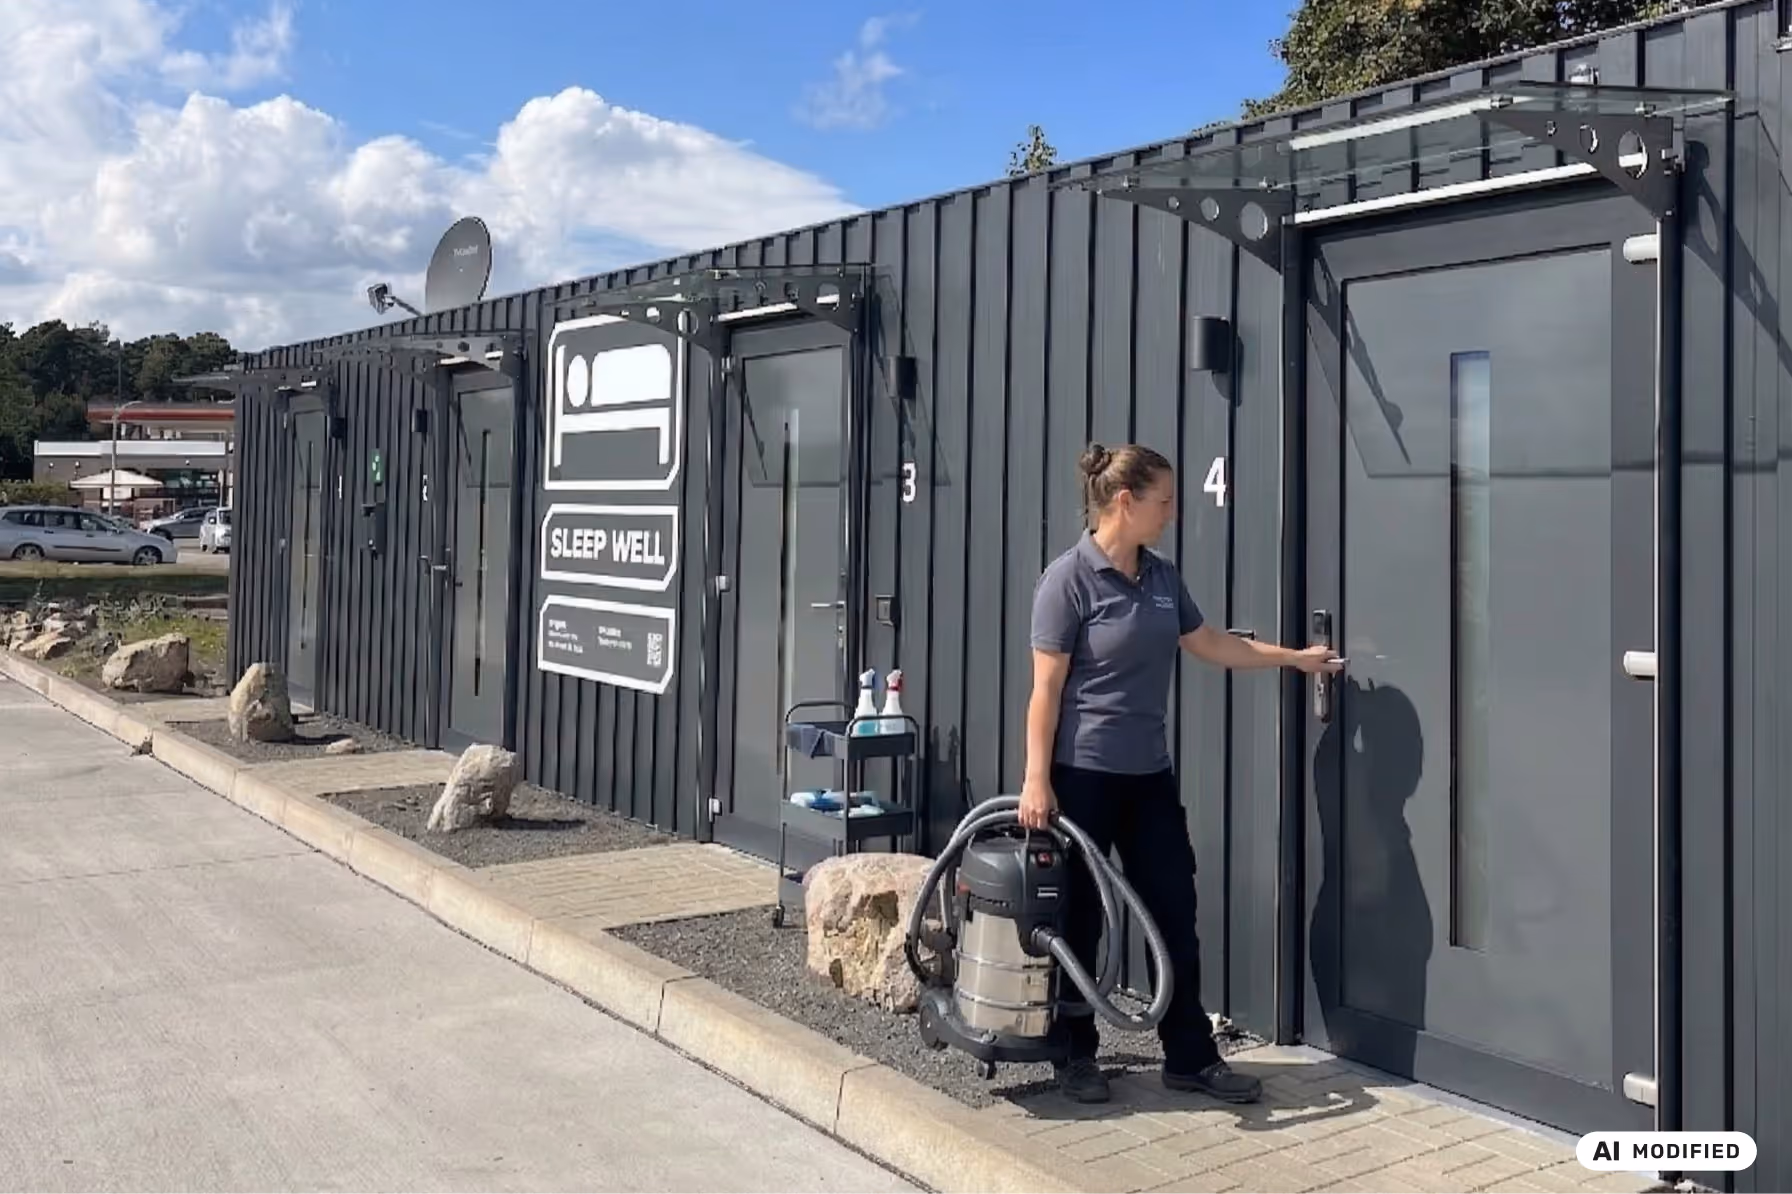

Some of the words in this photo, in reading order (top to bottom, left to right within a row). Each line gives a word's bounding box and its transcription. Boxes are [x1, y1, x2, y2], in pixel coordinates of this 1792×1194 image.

[903, 463, 916, 502] 3
[1204, 457, 1226, 507] 4
[551, 528, 607, 560] SLEEP
[612, 529, 665, 566] WELL
